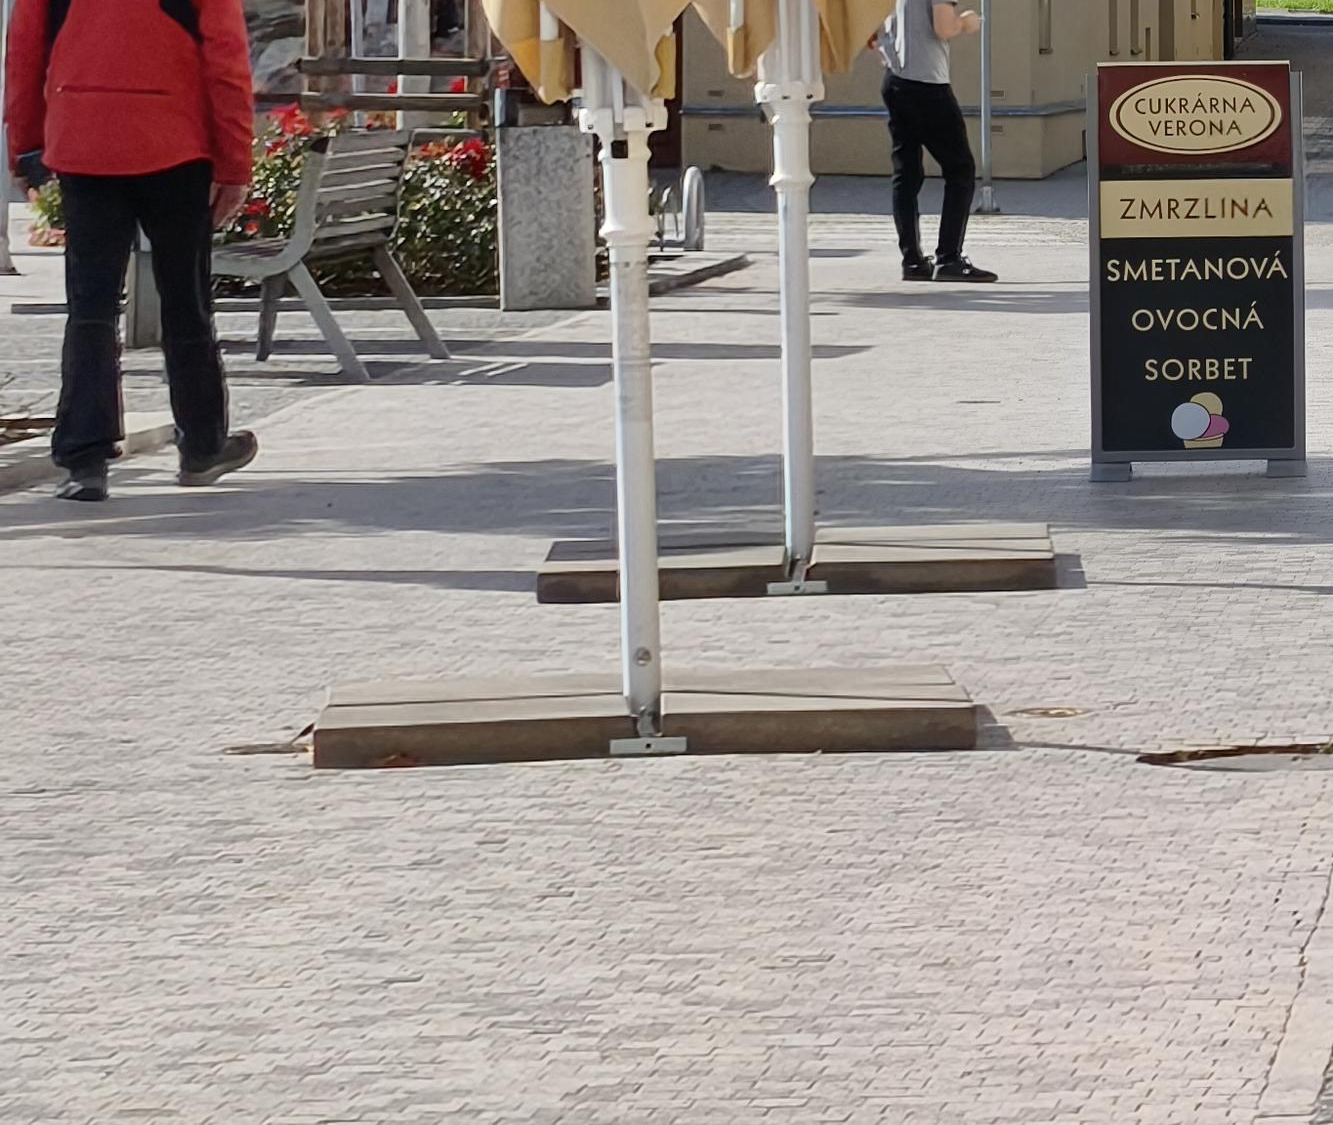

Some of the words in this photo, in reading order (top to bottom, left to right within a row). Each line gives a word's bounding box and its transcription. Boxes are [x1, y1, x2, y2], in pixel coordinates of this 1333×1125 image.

[1134, 92, 1255, 115] CUKRÁRNA
[1148, 119, 1242, 137] VERONA
[1119, 198, 1273, 220] ZMRZLINA
[1106, 250, 1288, 281] SMETANOVÁ
[1131, 300, 1264, 331] OVOCNÁ
[1144, 357, 1253, 381] SORBET
